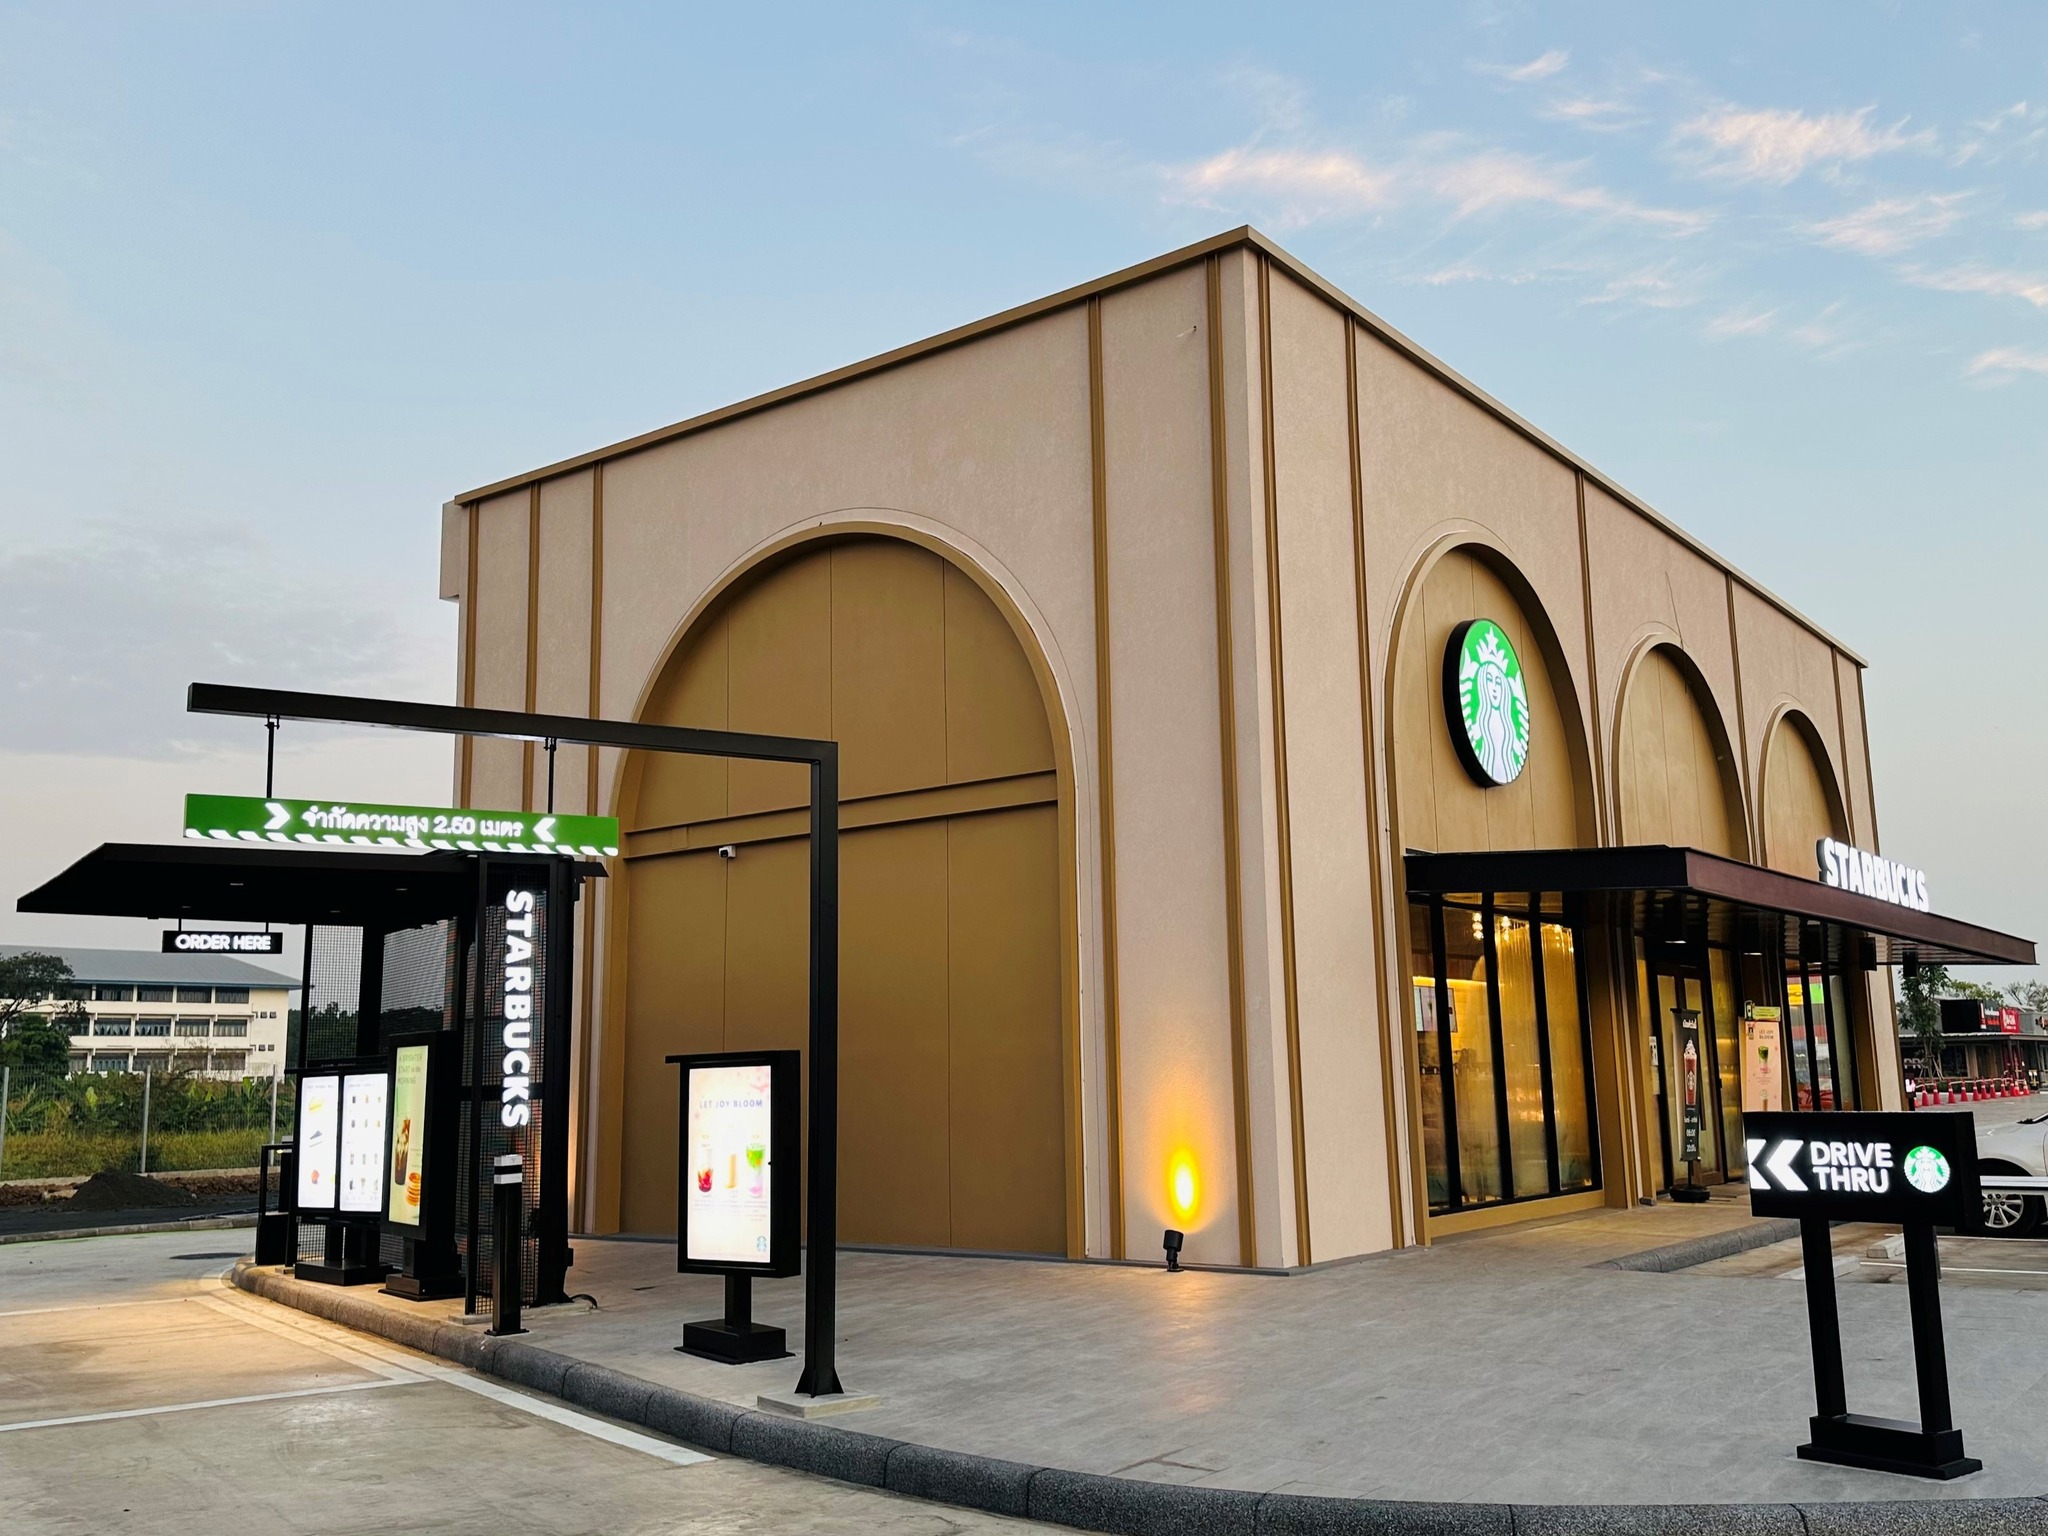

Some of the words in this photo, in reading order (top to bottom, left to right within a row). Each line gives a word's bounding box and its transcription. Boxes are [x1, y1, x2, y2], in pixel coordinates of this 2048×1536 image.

[302, 805, 429, 840] จำกัดความสูง
[433, 815, 476, 835] 2.50
[480, 819, 524, 838] เมตร
[1820, 836, 1930, 913] STARBUCKS
[174, 933, 231, 950] ORDER
[233, 934, 272, 951] HERE
[500, 888, 534, 1129] STARBUCKS
[699, 1099, 713, 1109] LET
[715, 1099, 730, 1109] JOY
[733, 1098, 763, 1108] BLOOM
[1809, 1140, 1894, 1168] DRIVE
[1812, 1166, 1891, 1194] THRU
